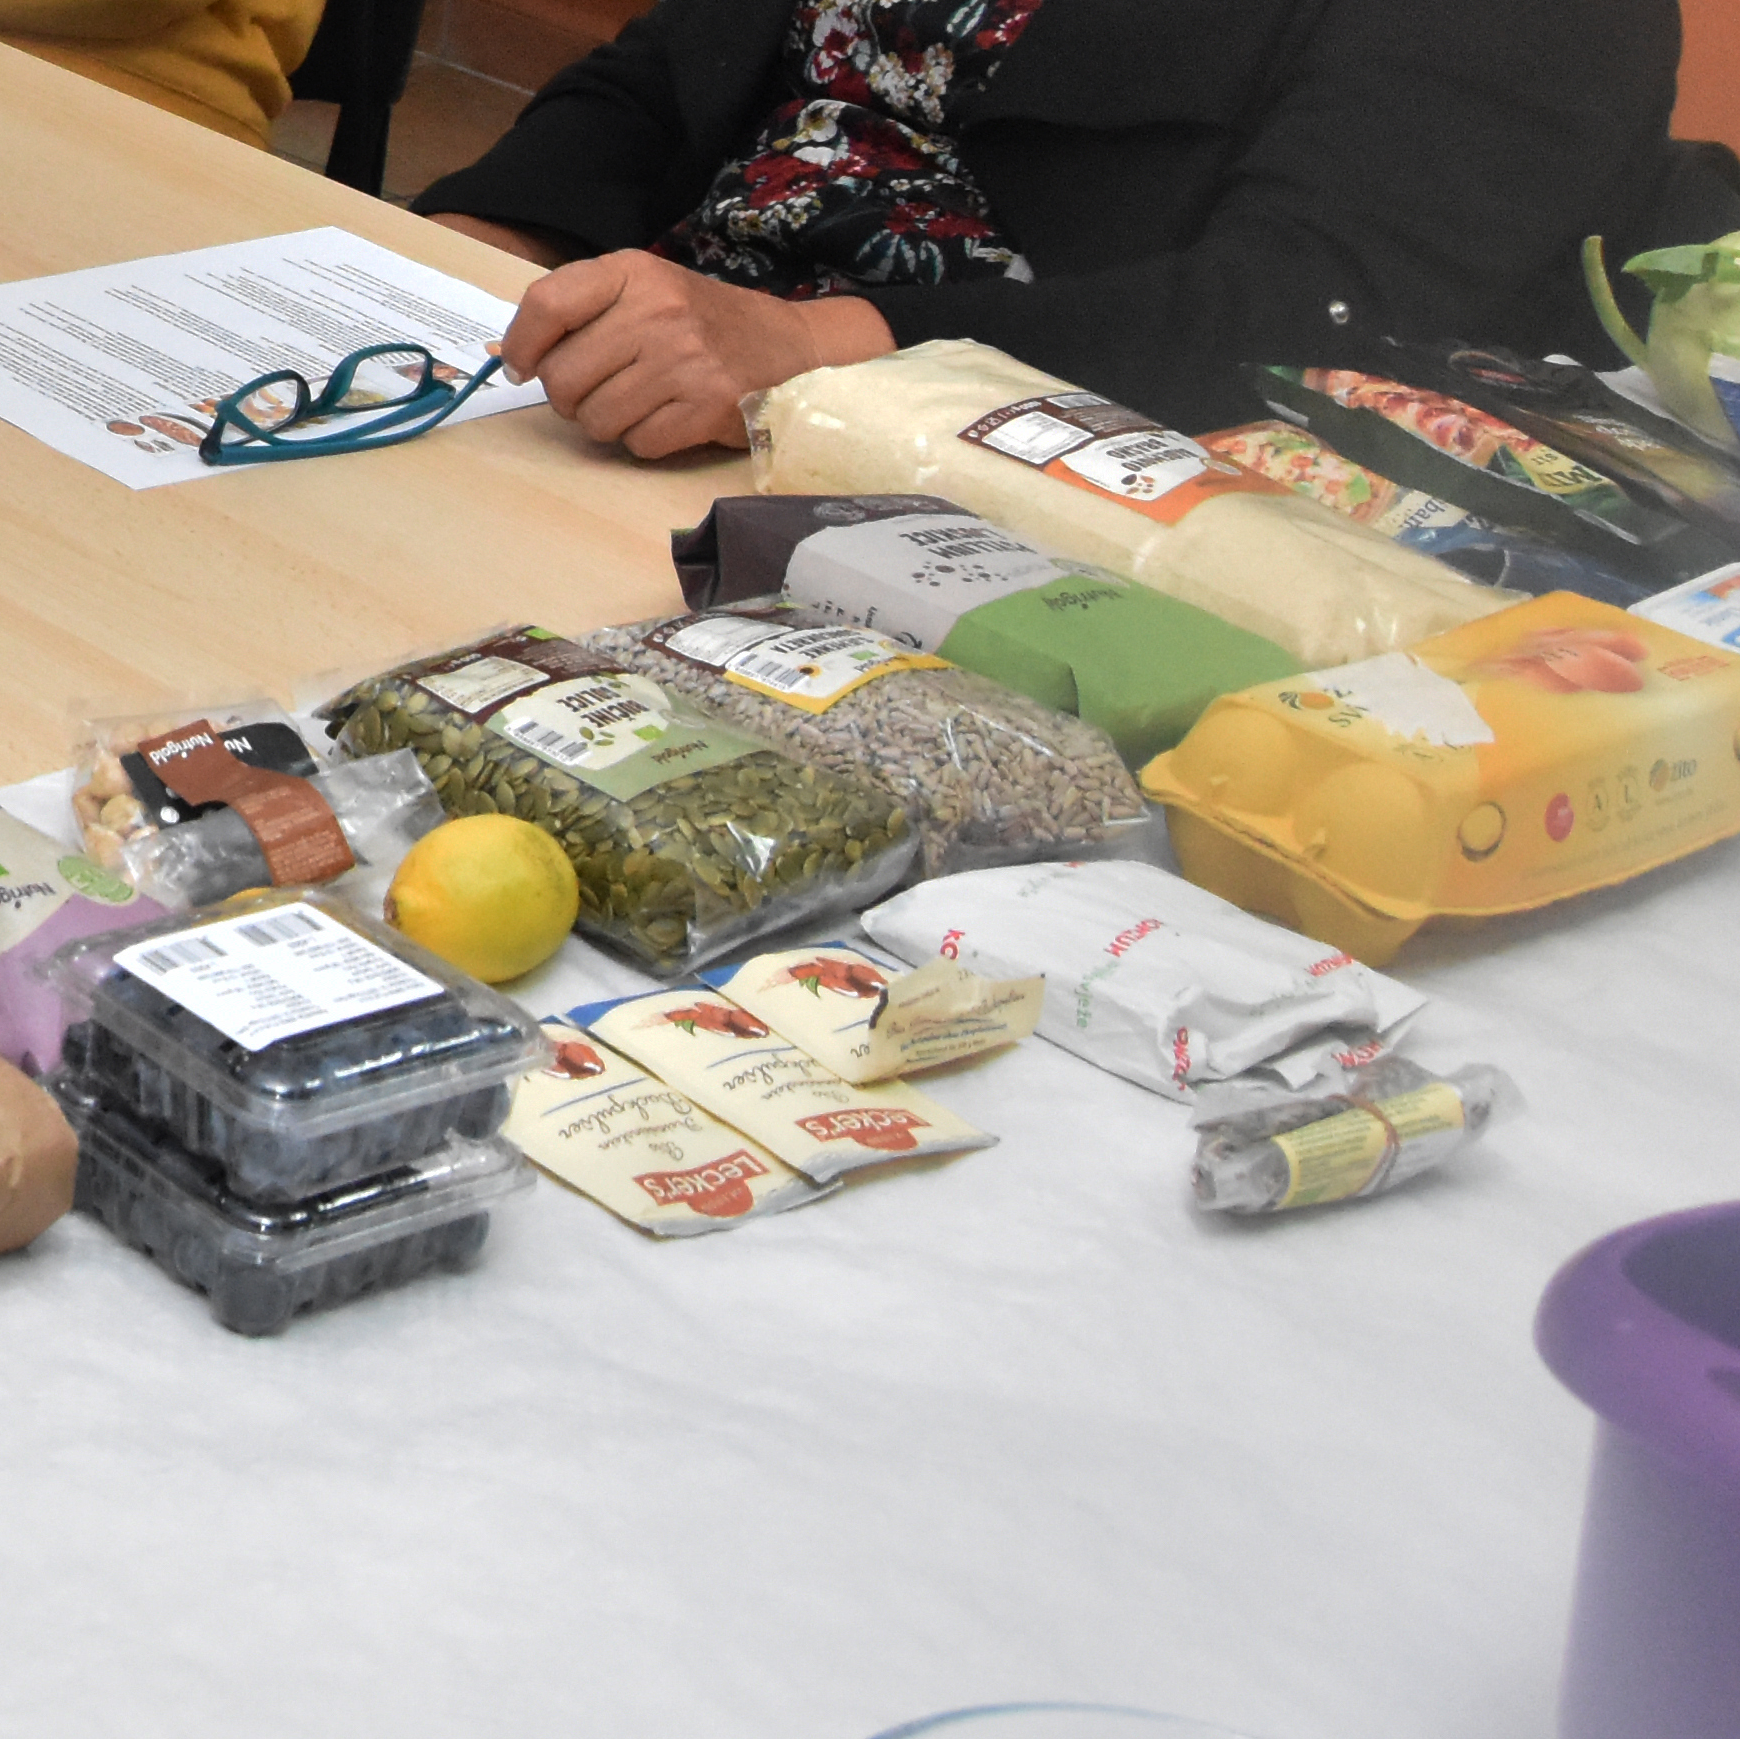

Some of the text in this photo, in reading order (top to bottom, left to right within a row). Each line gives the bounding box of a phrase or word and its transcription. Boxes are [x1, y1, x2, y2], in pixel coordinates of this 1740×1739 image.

[148, 731, 215, 766] Nutrigold
[803, 1108, 910, 1138] ecker's
[642, 1154, 764, 1199] Lecker's
